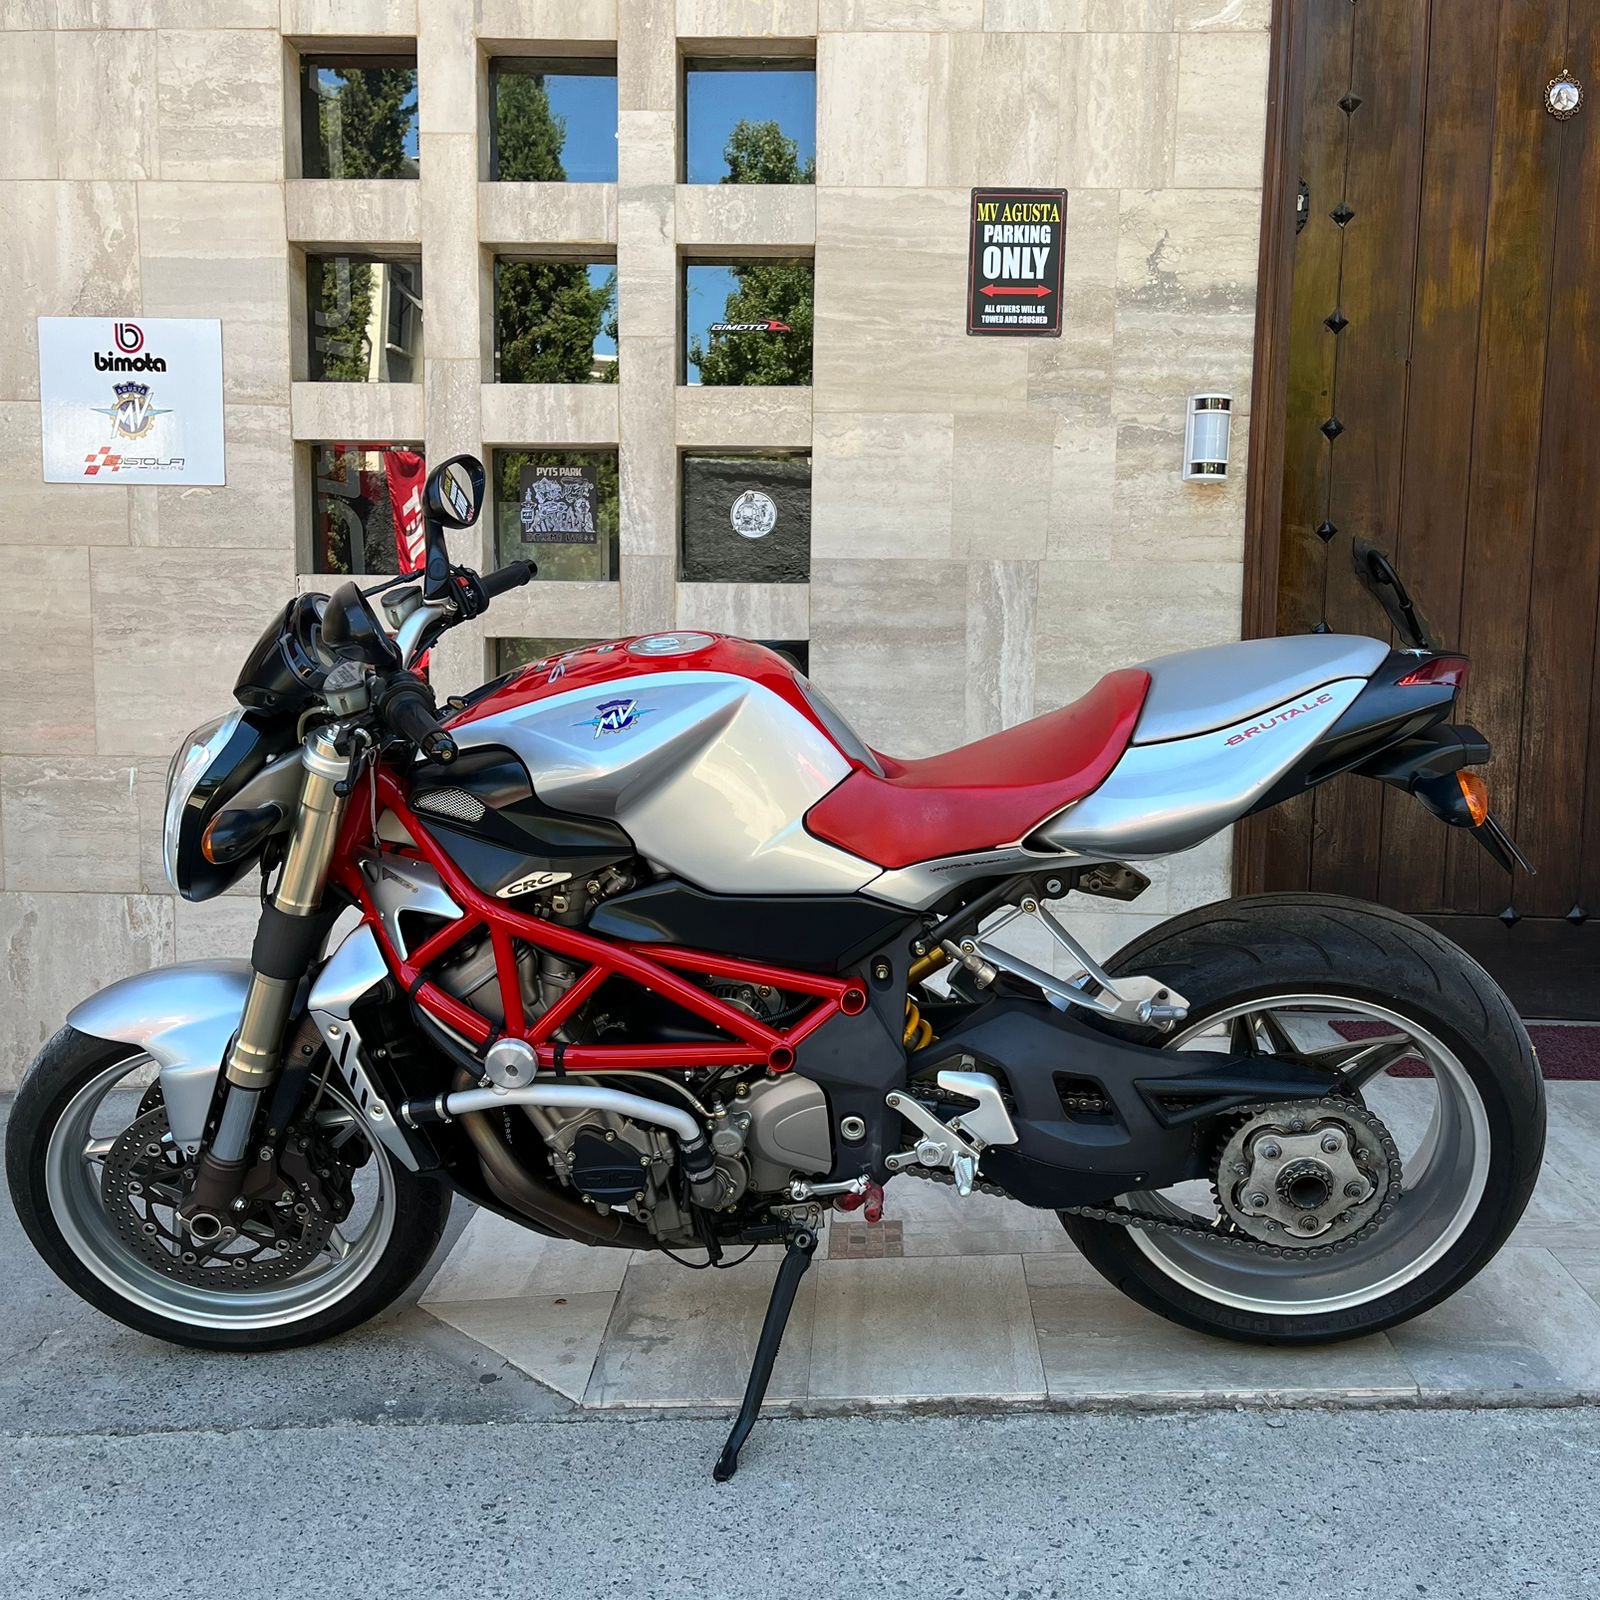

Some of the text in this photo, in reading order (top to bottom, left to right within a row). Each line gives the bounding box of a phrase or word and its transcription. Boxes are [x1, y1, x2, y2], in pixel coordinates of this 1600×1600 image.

[976, 203, 1060, 223] MV AGUSTA
[983, 224, 1052, 244] PARKING
[982, 245, 1051, 280] ONLY
[981, 315, 1048, 324] TOWED AND CRUSHED
[984, 304, 1046, 314] ALL OTHERS WILL BE
[94, 351, 167, 373] bimota
[117, 386, 146, 395] AGUSTA
[110, 392, 154, 439] MV
[536, 467, 582, 477] PYTS PARK
[594, 699, 639, 740] MV
[1224, 692, 1334, 746] BRUTALE
[506, 873, 553, 895] CRC
